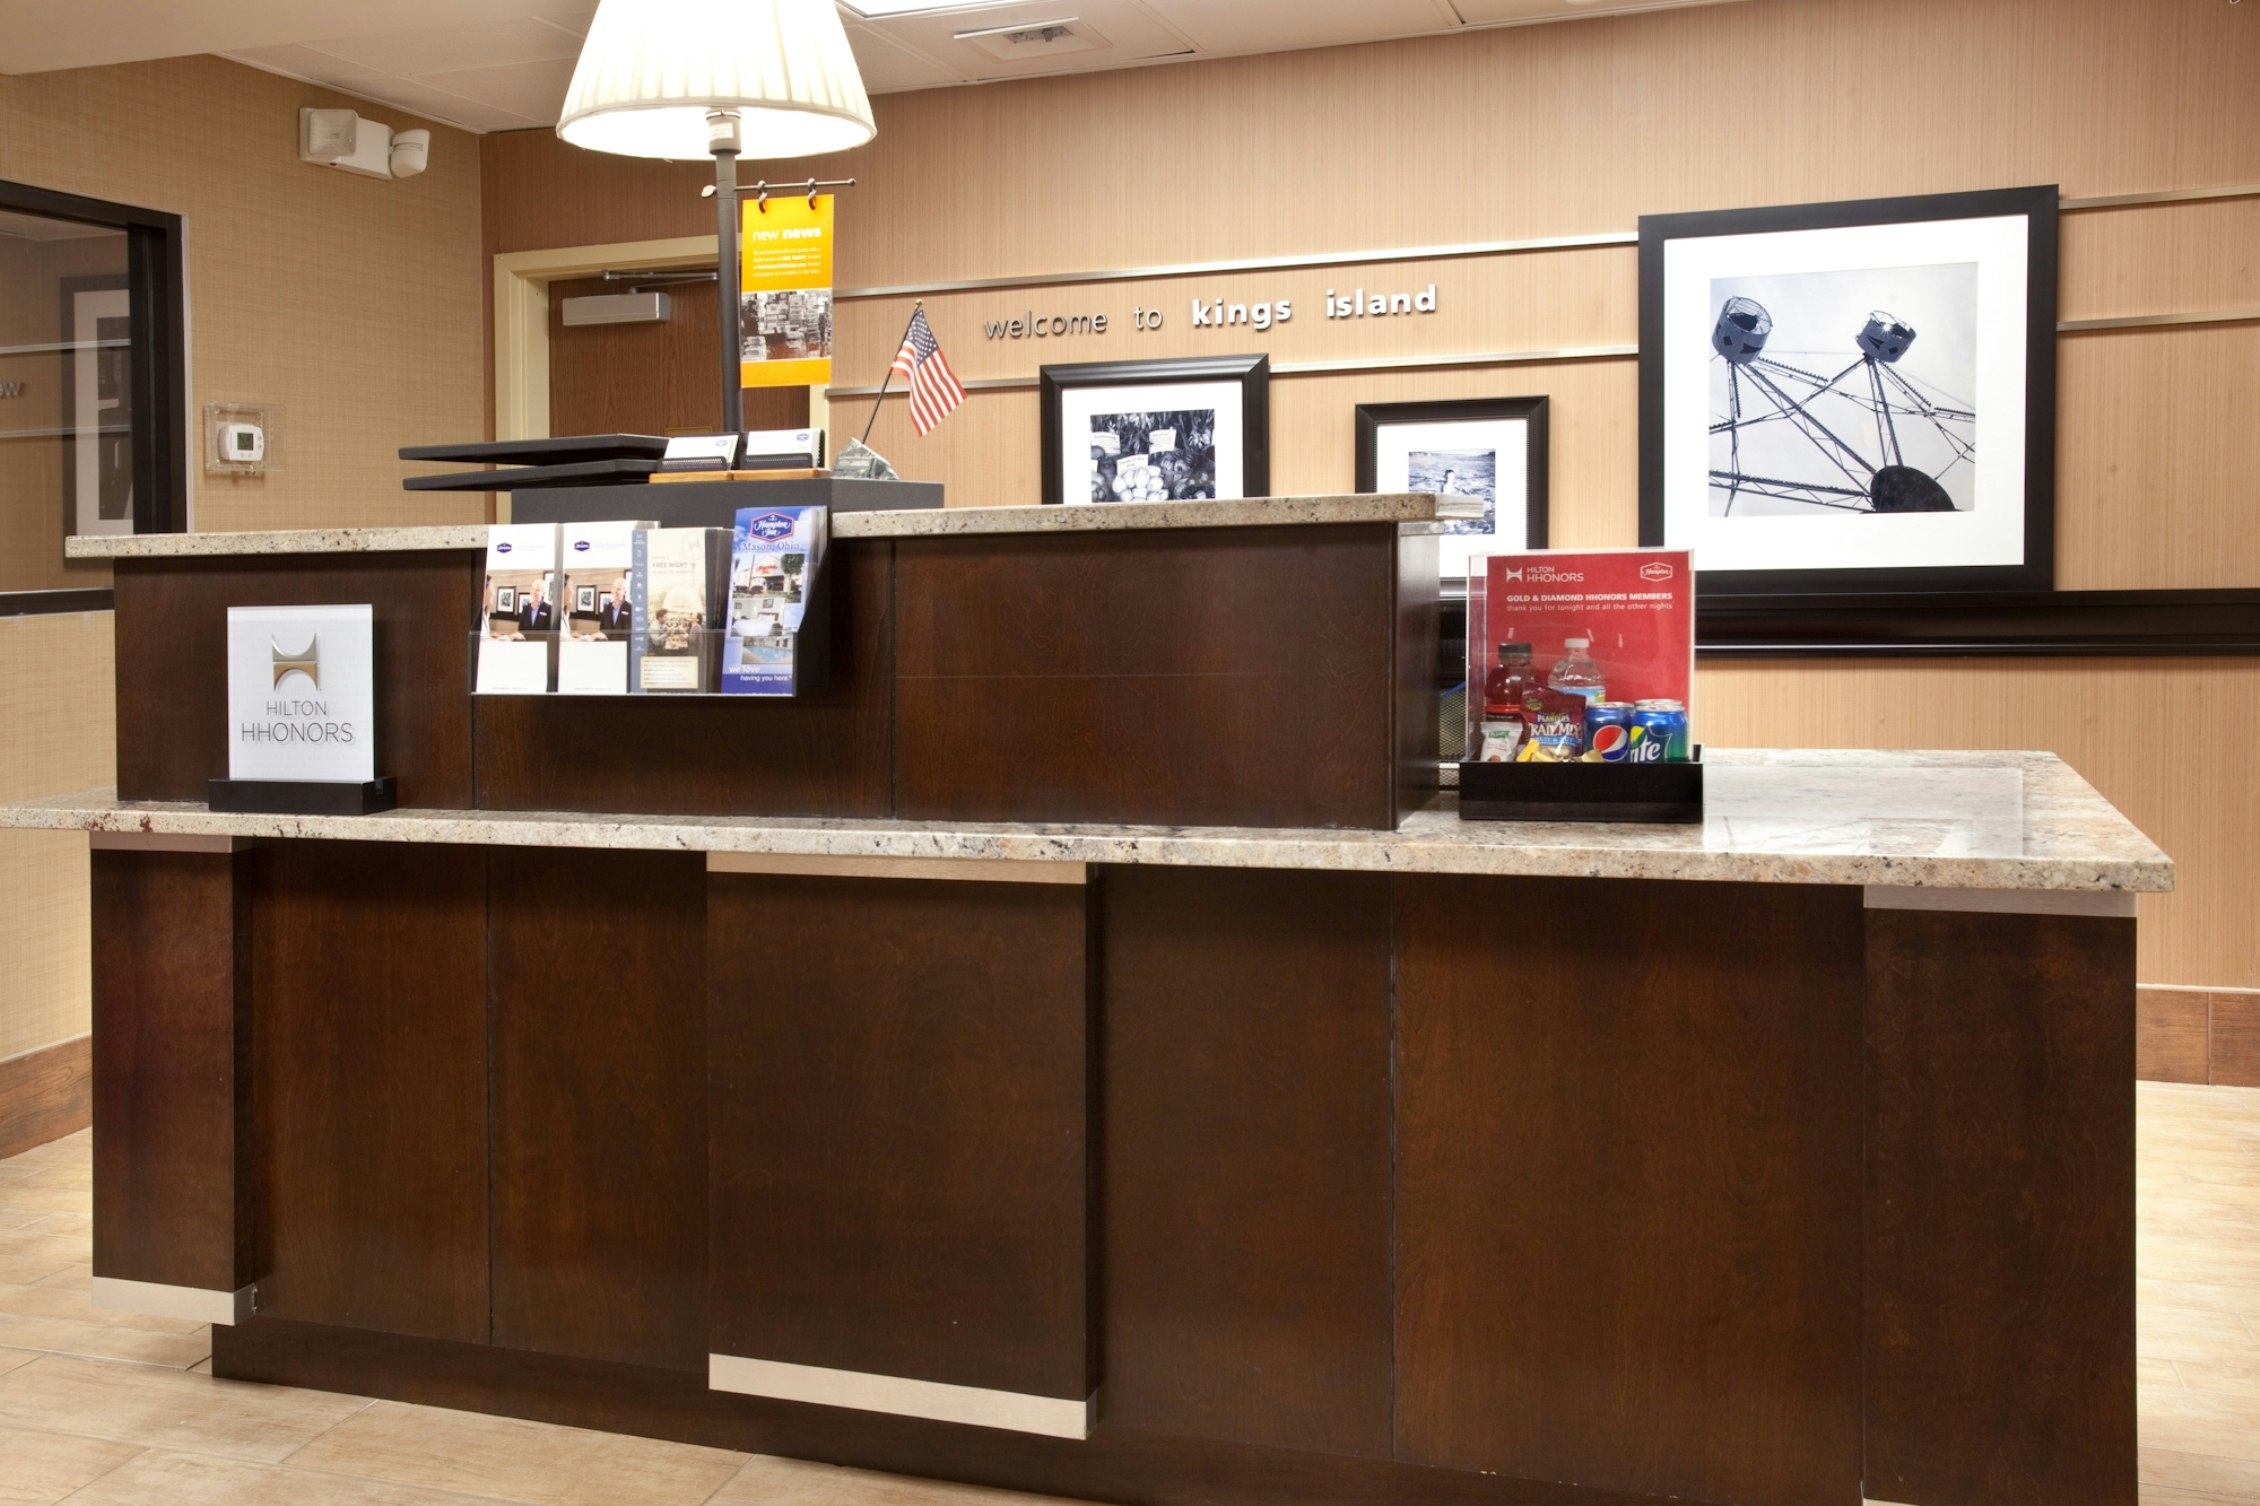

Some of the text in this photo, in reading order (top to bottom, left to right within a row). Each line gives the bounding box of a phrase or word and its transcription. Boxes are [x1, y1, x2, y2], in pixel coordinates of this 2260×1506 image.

[753, 227, 822, 241] new news
[983, 284, 1437, 340] welcome to kings island
[777, 541, 800, 551] Ohio
[1527, 573, 1584, 583] HHONORS
[1507, 592, 1673, 602] GOLD & DIAMOND HHONORS MEMBERS
[1506, 604, 1527, 612] thank
[1529, 605, 1542, 613] you
[1557, 603, 1584, 613] tonight
[1585, 603, 1600, 611] and
[1627, 602, 1647, 610] other
[1649, 602, 1673, 611] nights
[742, 664, 760, 673] love
[740, 674, 760, 683] having
[266, 701, 328, 716] HILTON
[241, 722, 353, 742] HHONORS
